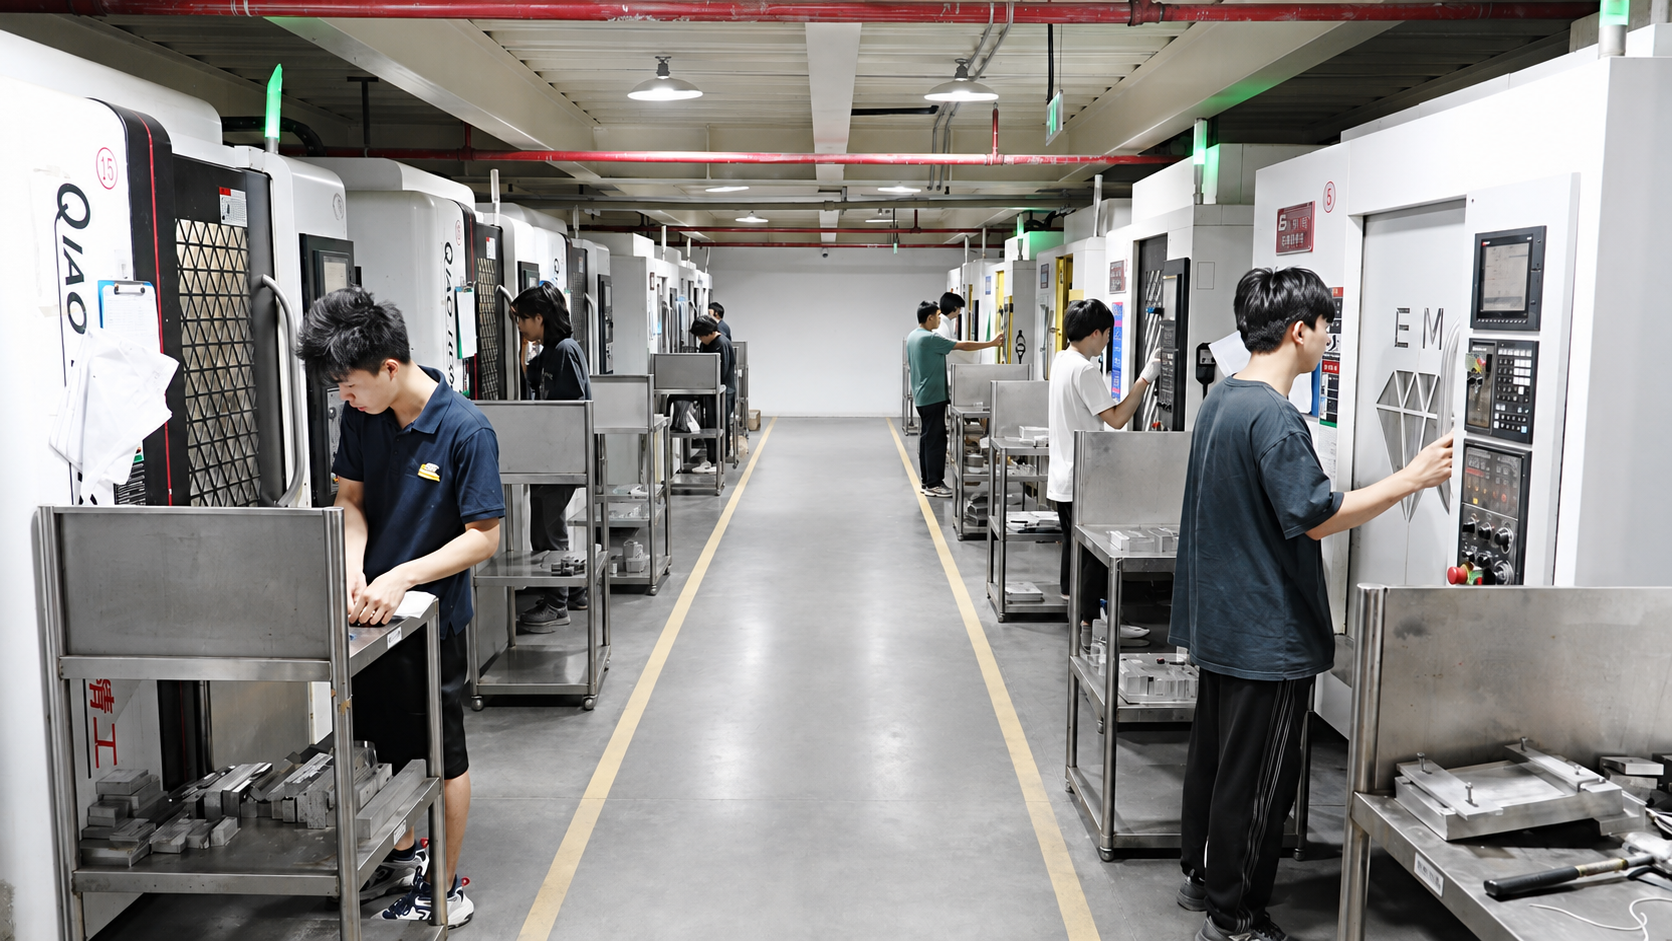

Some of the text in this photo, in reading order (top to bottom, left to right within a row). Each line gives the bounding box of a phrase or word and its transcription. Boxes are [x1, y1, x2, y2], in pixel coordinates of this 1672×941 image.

[101, 156, 115, 182] 15
[56, 182, 91, 335] QIAO
[444, 241, 454, 317] QIAO
